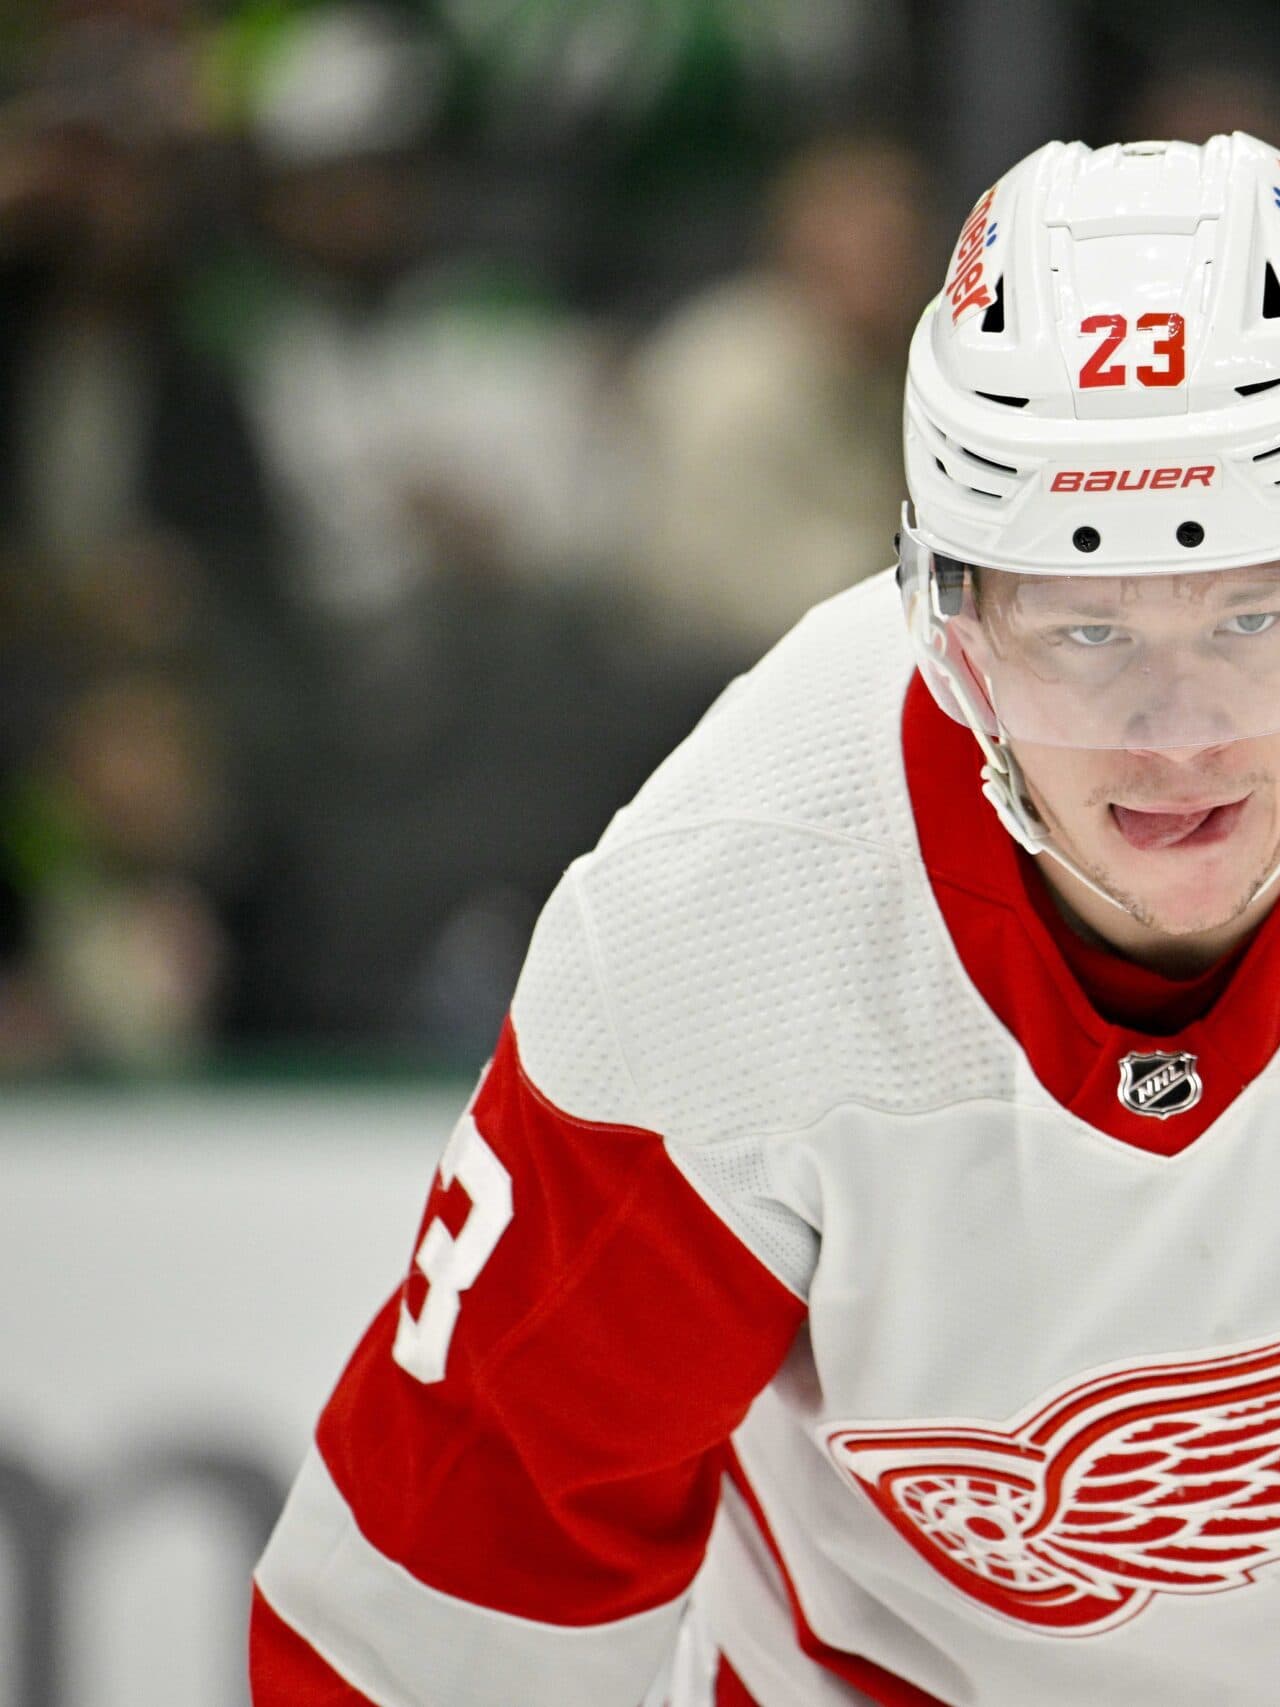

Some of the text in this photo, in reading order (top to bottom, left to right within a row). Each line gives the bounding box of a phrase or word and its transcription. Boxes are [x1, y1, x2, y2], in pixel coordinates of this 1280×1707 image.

[1078, 312, 1186, 389] 23
[1049, 465, 1216, 493] BAUER
[1137, 1065, 1184, 1103] NHL
[392, 1056, 514, 1384] 3
